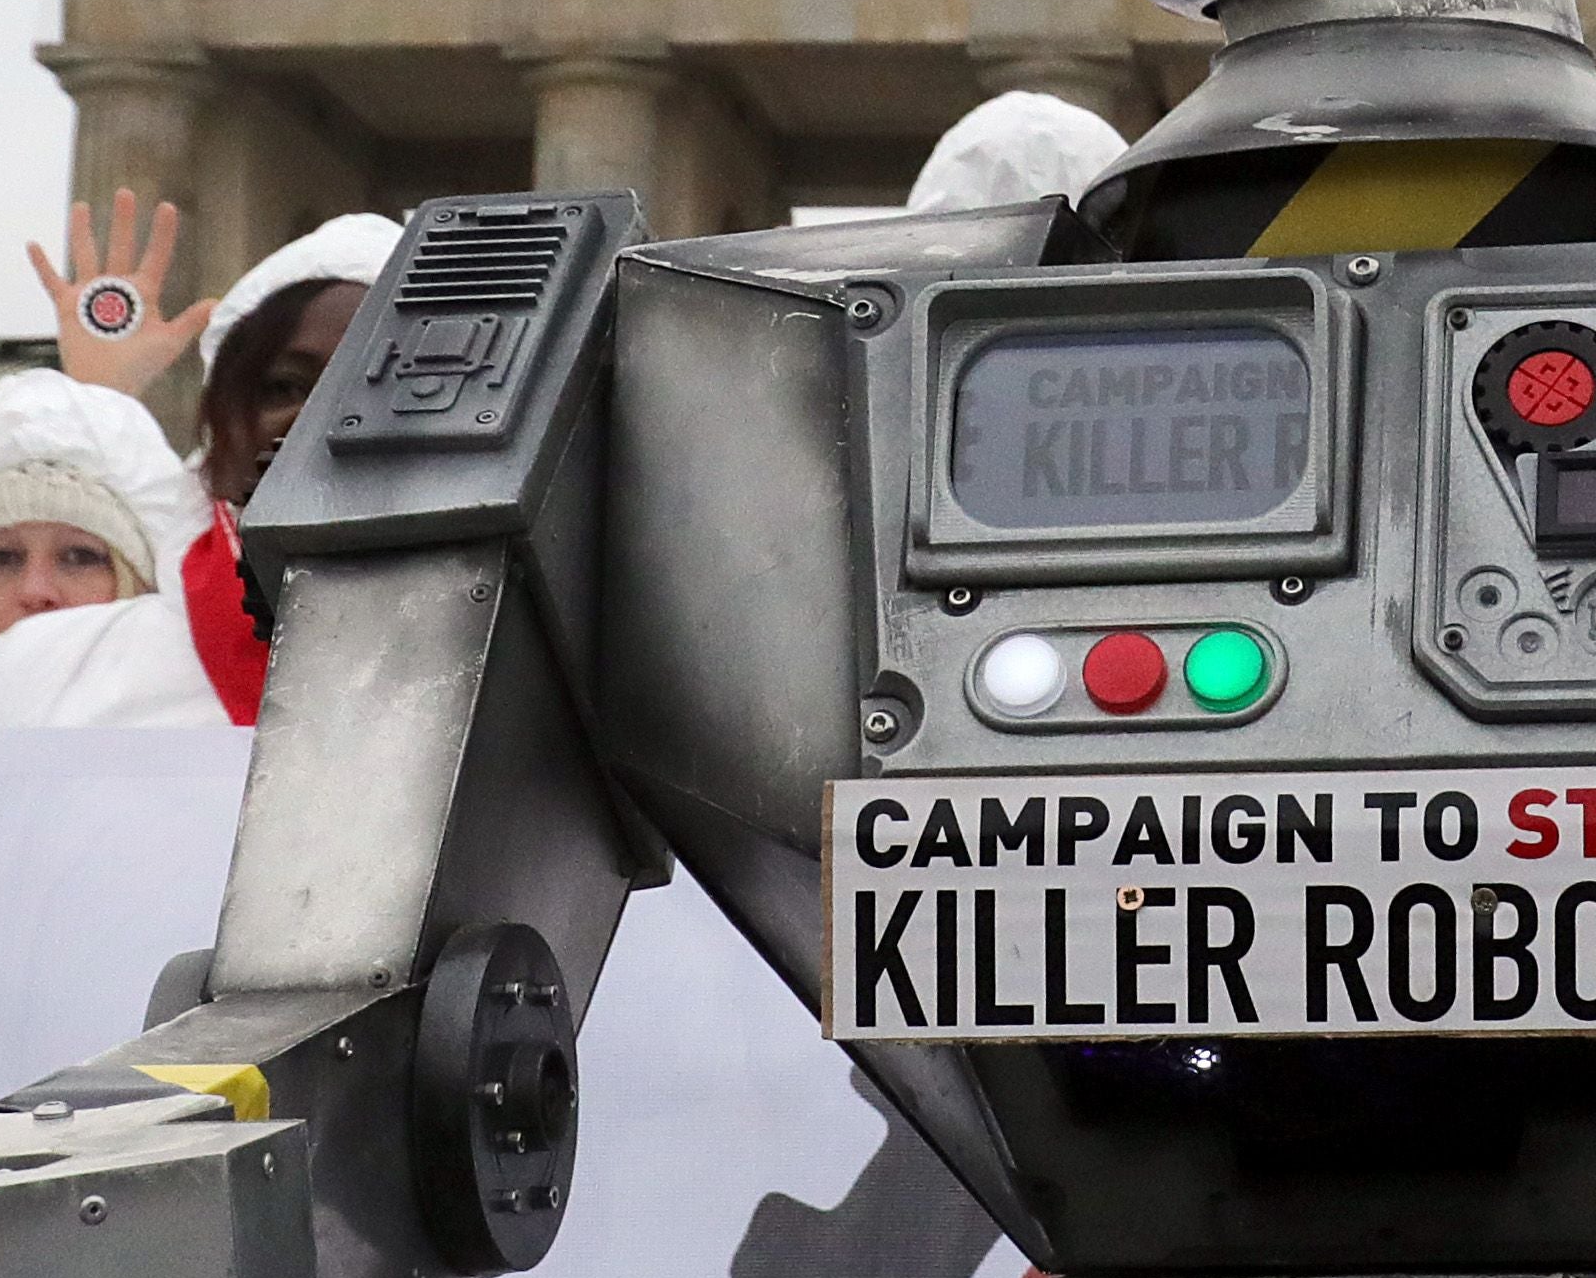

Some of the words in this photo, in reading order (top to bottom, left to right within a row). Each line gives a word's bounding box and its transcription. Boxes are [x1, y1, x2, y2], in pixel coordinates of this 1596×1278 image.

[1027, 360, 1303, 410] CAMPAIGN
[1021, 415, 1252, 499] KILLER
[856, 793, 1333, 869] CAMPAIGN
[1365, 790, 1479, 863] TO
[855, 886, 1260, 1028] KILLER
